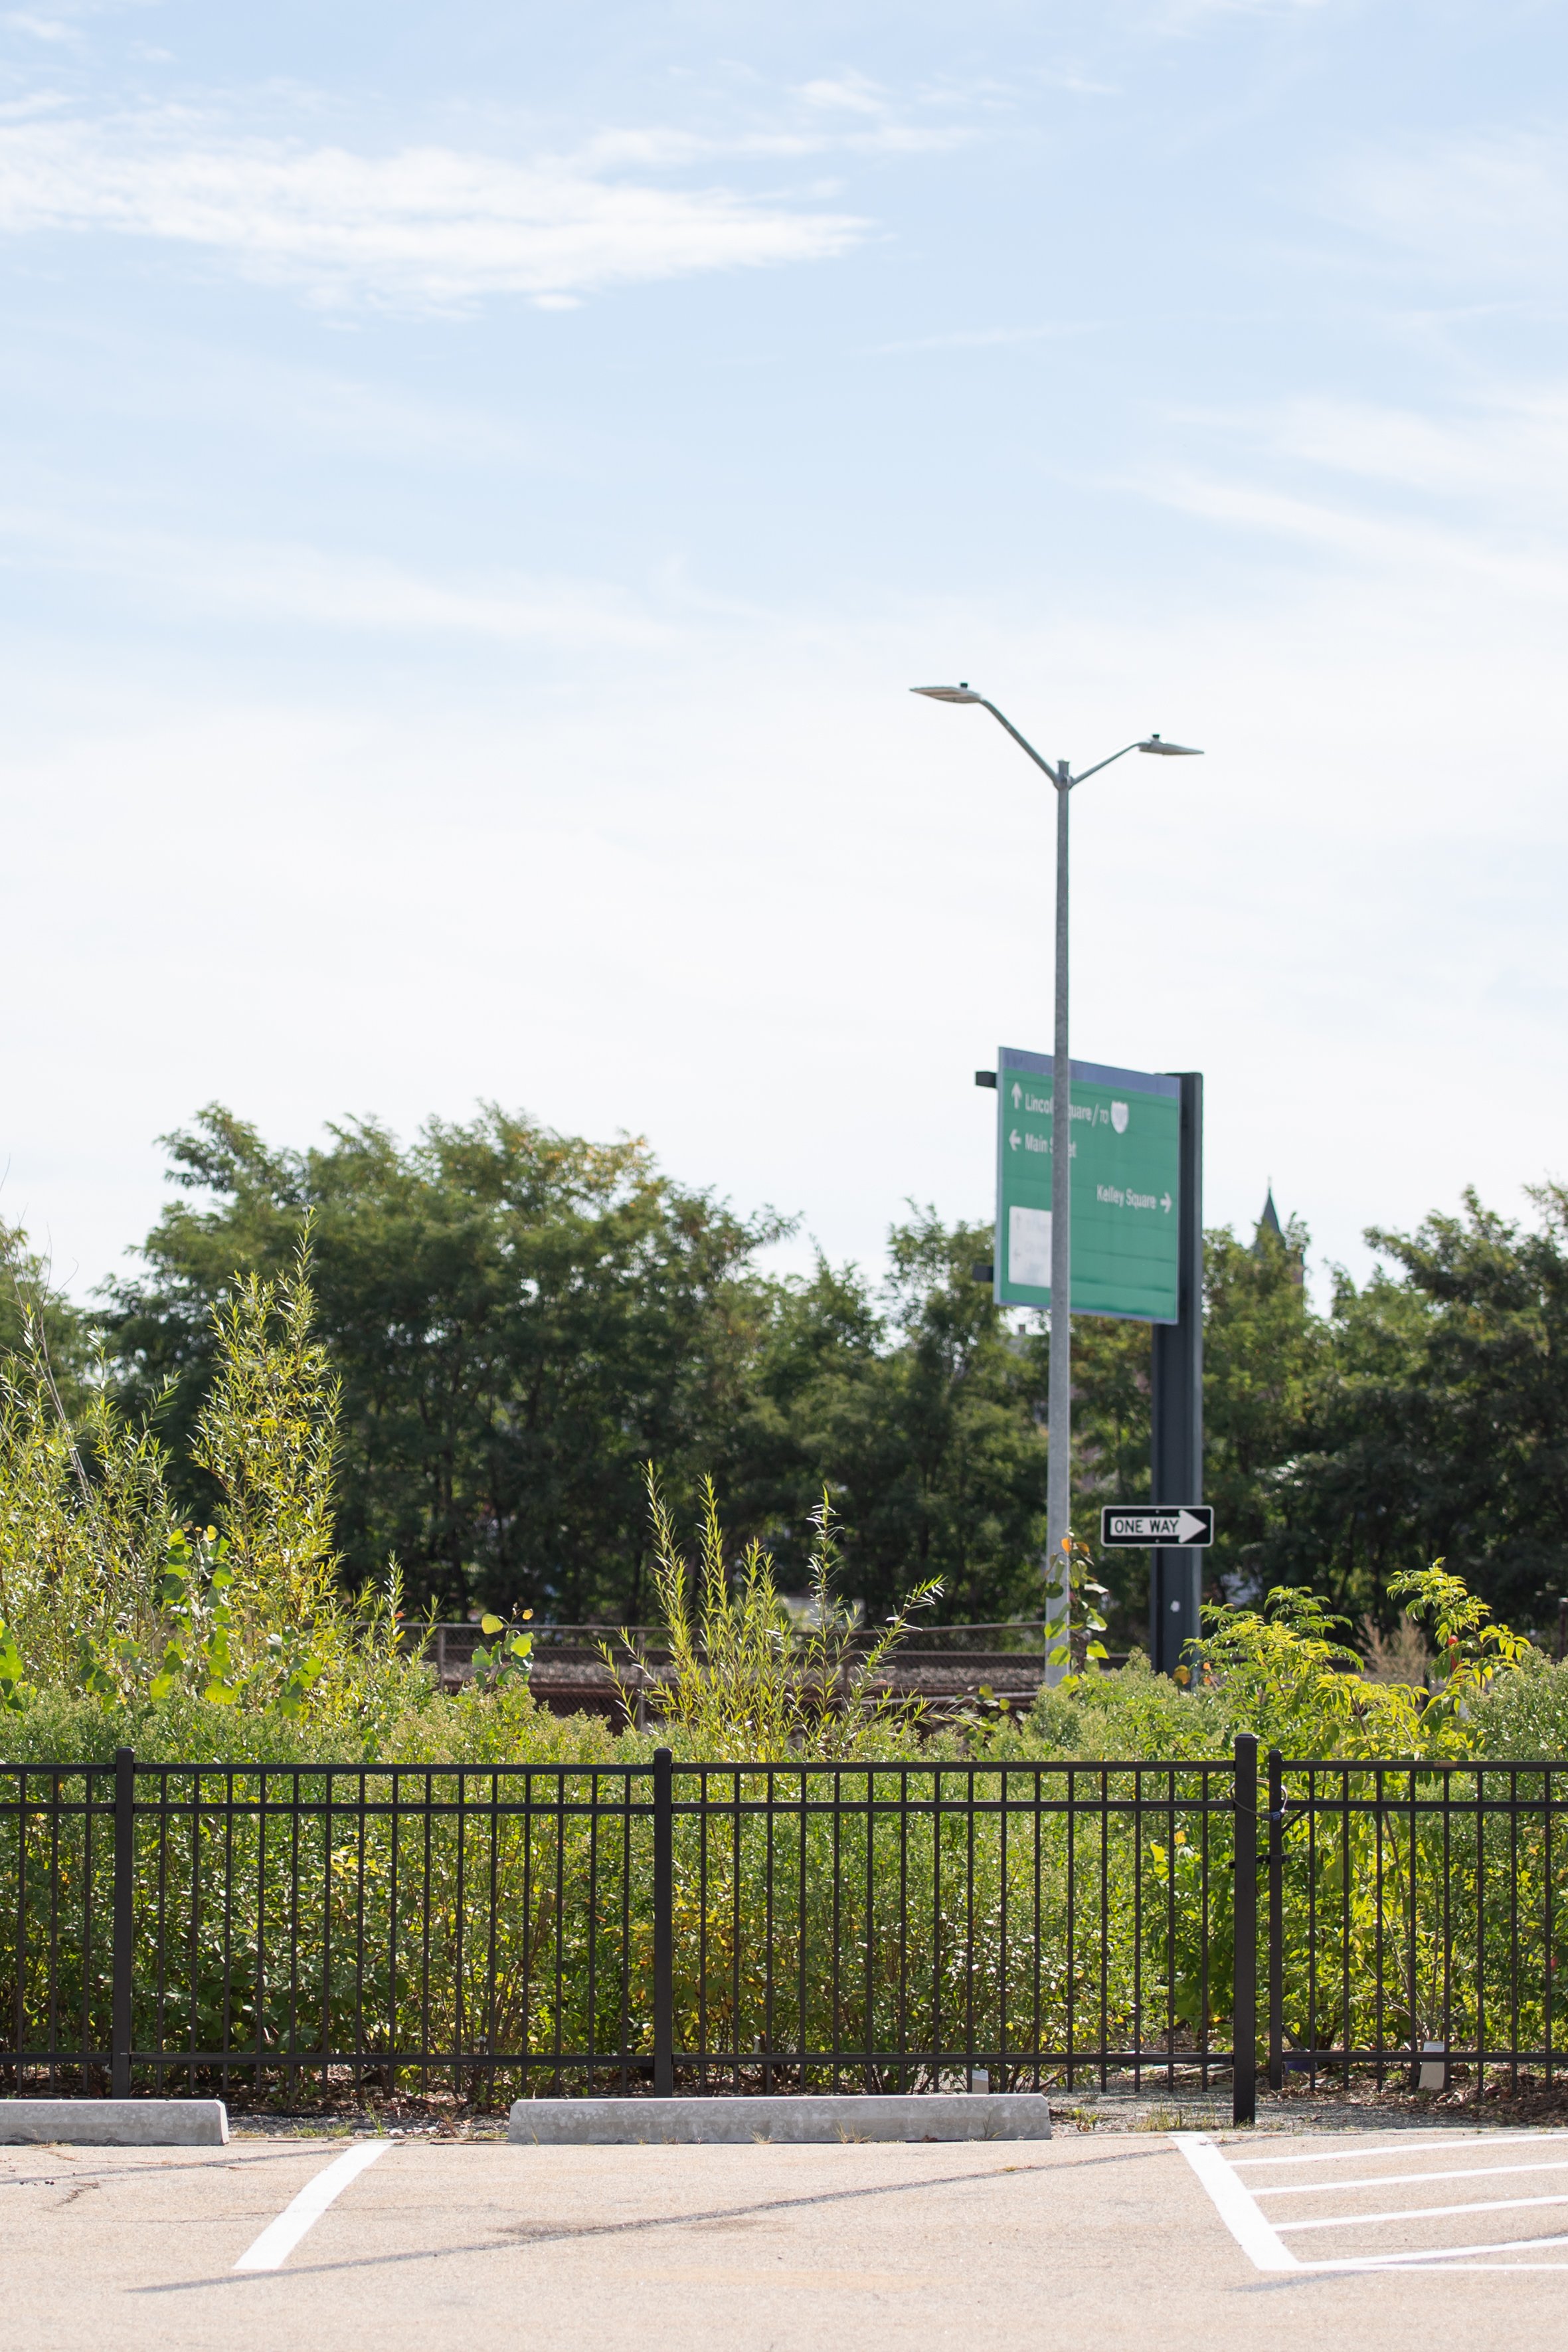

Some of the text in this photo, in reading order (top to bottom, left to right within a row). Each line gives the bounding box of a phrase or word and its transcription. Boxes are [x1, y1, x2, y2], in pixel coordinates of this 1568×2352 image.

[1025, 1093, 1053, 1114] Lincol
[1068, 1105, 1092, 1121] quare
[1025, 1133, 1048, 1153] Main
[1096, 1184, 1156, 1210] Kelley Square
[1114, 1519, 1179, 1534] ONE WAY
